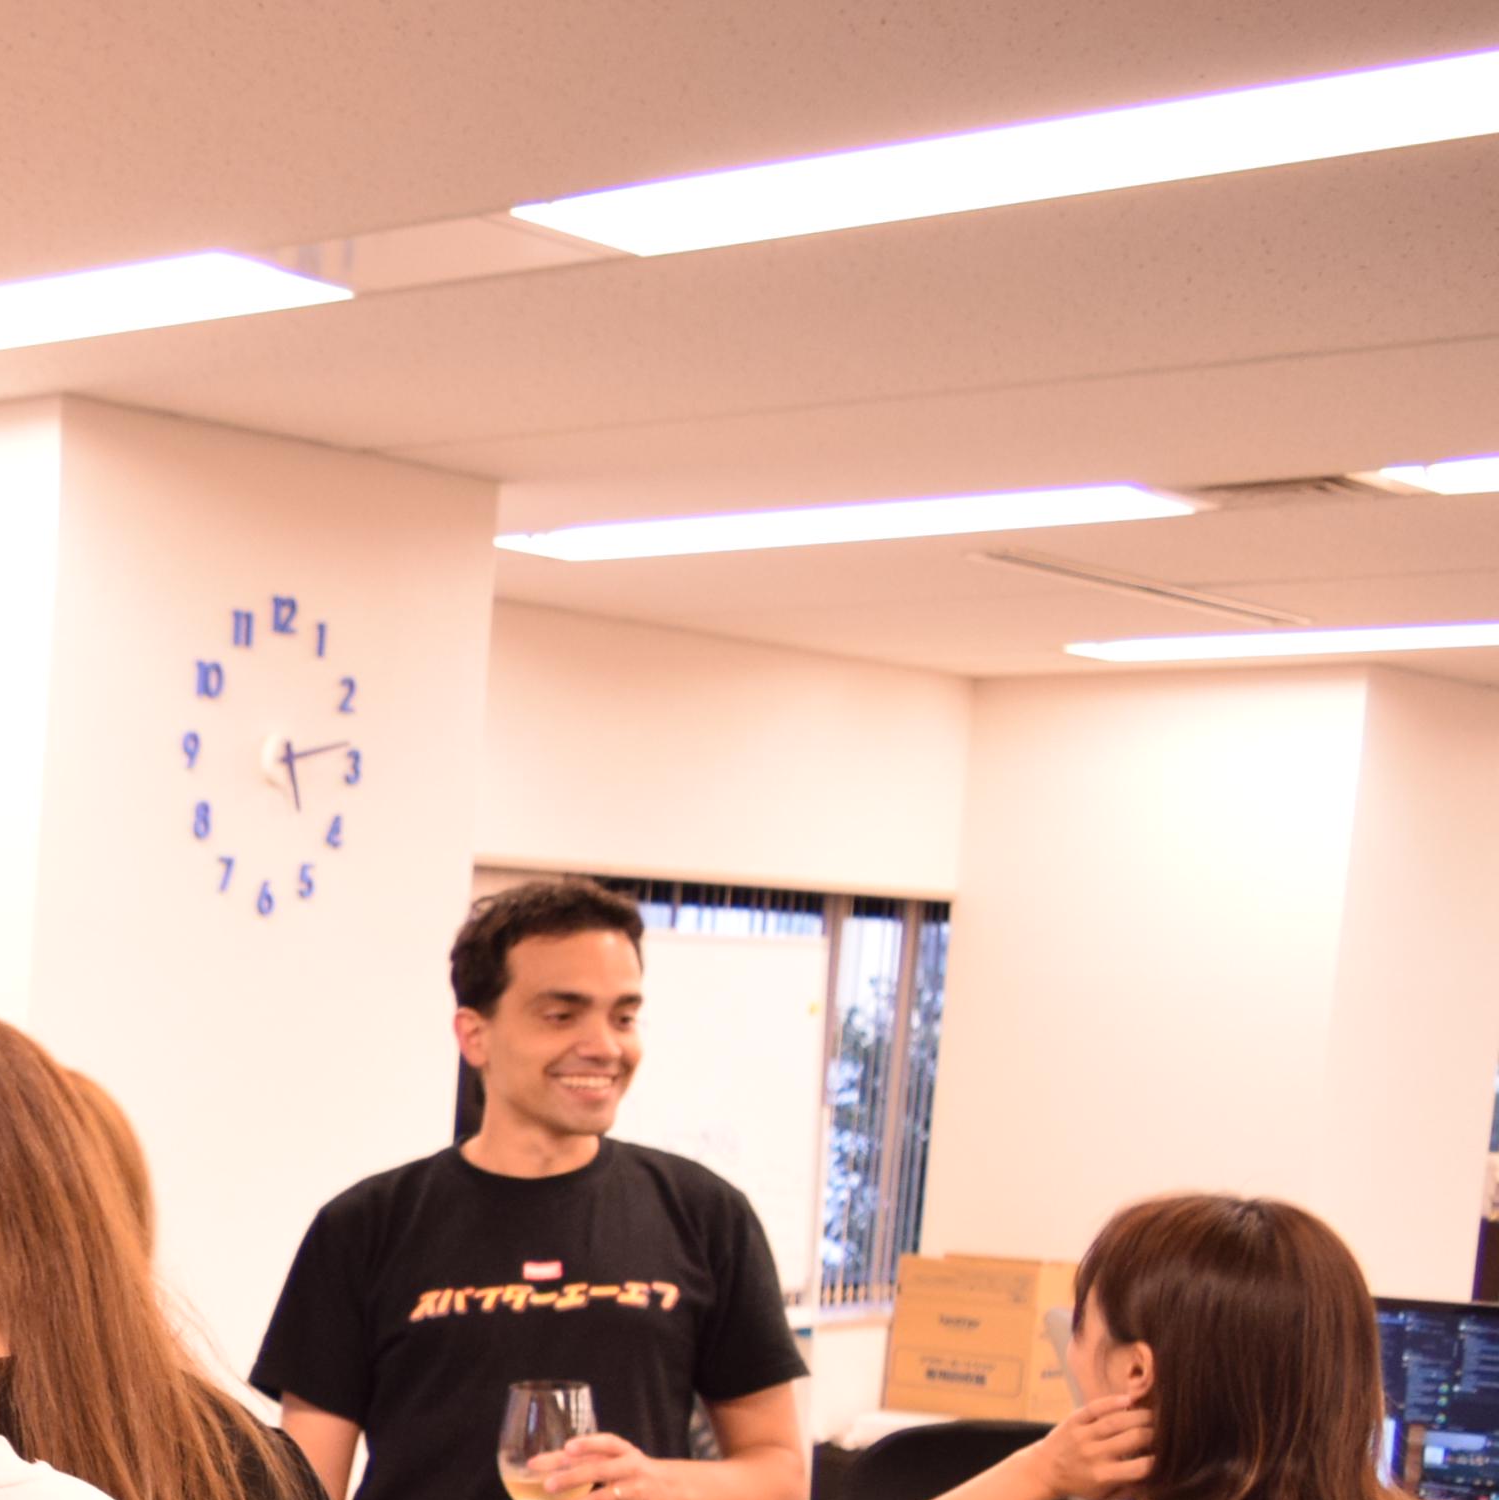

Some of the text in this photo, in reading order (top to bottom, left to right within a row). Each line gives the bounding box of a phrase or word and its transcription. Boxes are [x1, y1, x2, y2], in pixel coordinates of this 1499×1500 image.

[233, 610, 254, 648] 11
[272, 595, 298, 634] 12
[317, 622, 327, 657] 1
[196, 660, 224, 698] 10
[339, 677, 356, 713] 2
[183, 732, 200, 768] 9
[344, 749, 361, 785] 3
[193, 801, 211, 839] 8
[220, 857, 234, 890] 7
[299, 864, 314, 898] 5
[257, 882, 274, 915] 6
